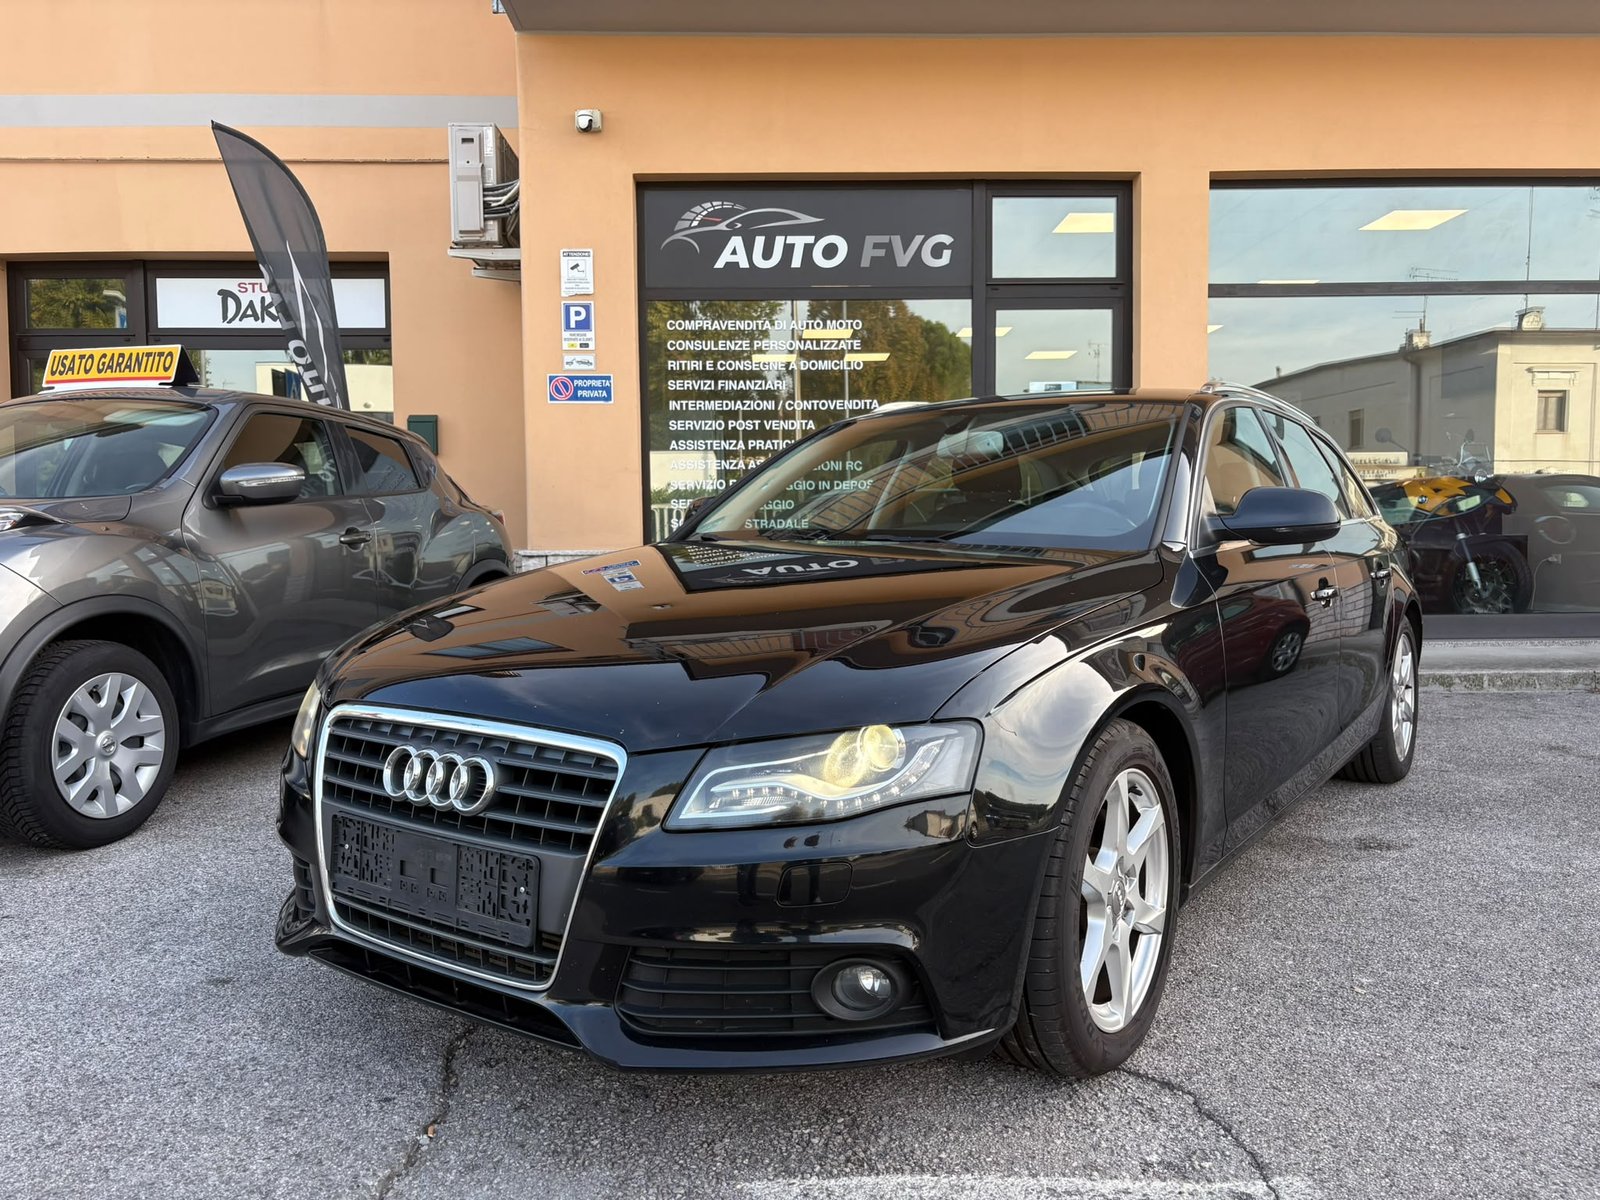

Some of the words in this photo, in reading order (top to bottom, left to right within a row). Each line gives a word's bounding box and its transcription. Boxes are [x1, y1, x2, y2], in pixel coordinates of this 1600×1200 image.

[713, 235, 848, 269] AUTO
[860, 234, 954, 269] FVG
[237, 282, 271, 294] STU
[217, 289, 280, 324] DAK
[569, 306, 587, 328] P
[666, 319, 772, 331] COMPRAVENDITA
[774, 319, 787, 330] DI
[790, 319, 823, 330] AUTO
[826, 319, 863, 330] MOTO
[666, 340, 751, 351] CONSULENZE
[753, 339, 862, 351] PERSONALIZZATE
[50, 353, 95, 377] USATO
[96, 350, 174, 375] GARANTITO
[667, 360, 703, 371] RITIRI
[705, 360, 714, 371] E
[717, 360, 786, 371] CONSEGNE
[788, 360, 798, 371] A
[800, 359, 864, 371] DOMICILIO
[667, 379, 715, 391] SERVIZI
[717, 379, 786, 391] FINANZIARI
[577, 390, 608, 398] PRIVATA
[668, 400, 776, 411] INTERMEDIAZIONI
[785, 399, 880, 411] CONTOVENDITA
[668, 420, 725, 431] SERVIZIO
[727, 420, 761, 431] POST
[763, 420, 816, 431] VENDITA
[669, 440, 746, 451] ASSISTENZA
[747, 440, 796, 451] PRATIC
[671, 459, 746, 471] ASSISTENZA
[845, 460, 863, 471] RC
[670, 479, 726, 491] SERVIZIO
[818, 480, 831, 491] IN
[833, 480, 874, 491] DEPOS
[744, 518, 809, 530] STRADALE
